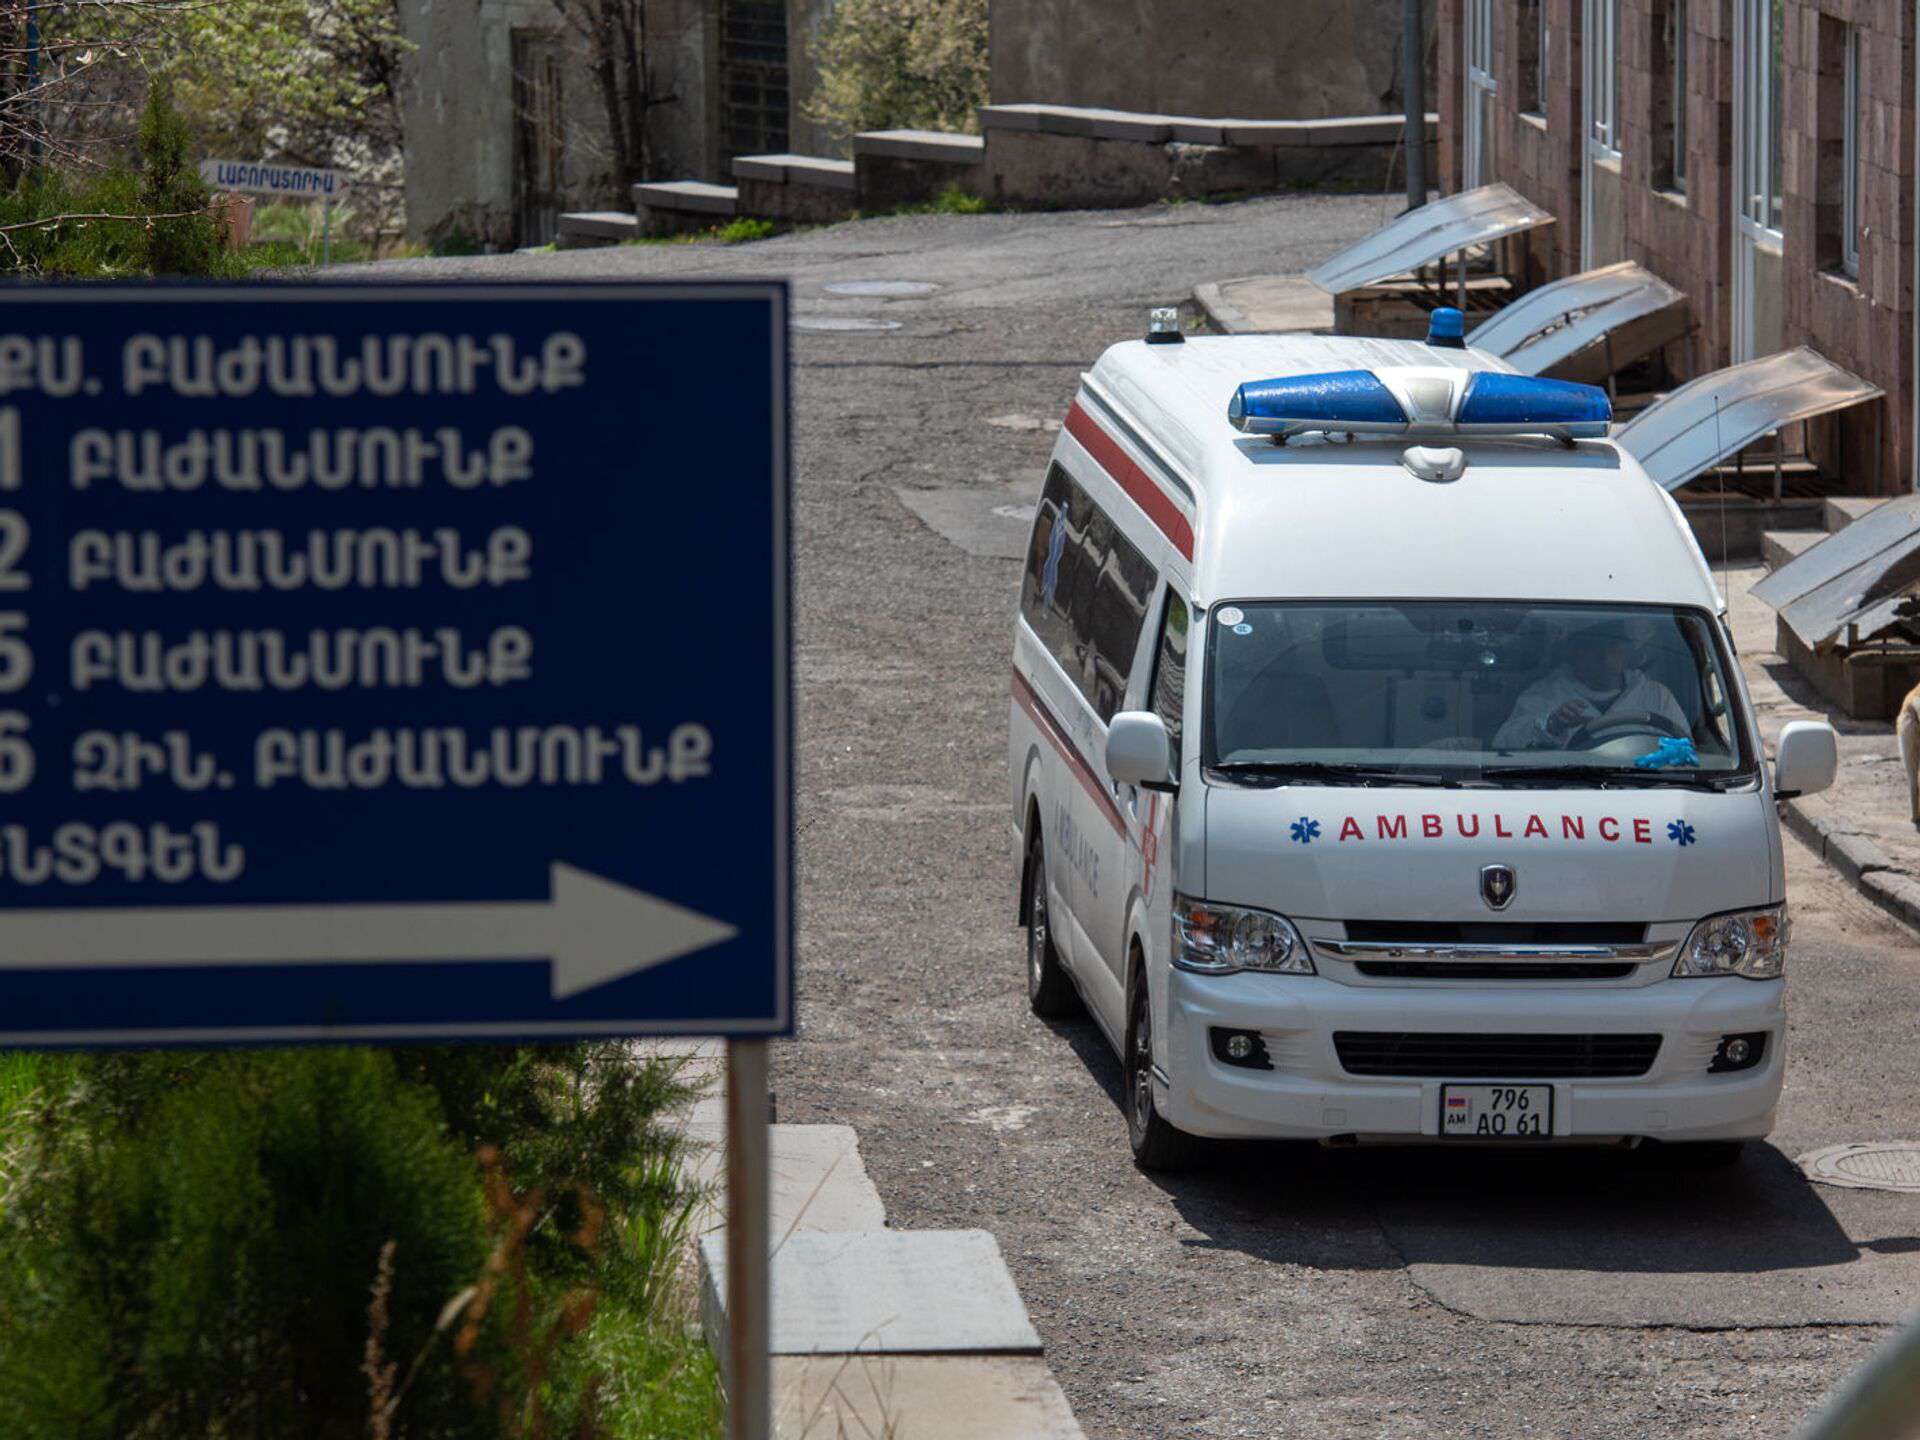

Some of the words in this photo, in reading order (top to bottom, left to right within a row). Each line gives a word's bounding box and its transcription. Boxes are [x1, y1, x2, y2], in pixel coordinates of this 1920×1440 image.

[217, 164, 334, 193] ԼԱԲՈՐԱՏՈՐԻԱ
[123, 332, 586, 397] ԲԱԺԱՆՄՈՒՆՔ
[70, 426, 533, 491] ԲԱԺԱՆՄՈՒՆՔ
[69, 526, 532, 591] ԲԱԺԱՆՄՈՒՆՔ
[71, 626, 533, 691] ԲԱԺԱՆՄՈՒՆՔ
[255, 723, 713, 790] ԲԱԺԱՆՄՈՒՆՔ
[0, 822, 245, 884] ՆՏԳԵՆ
[1338, 813, 1653, 845] AMBULANCE
[1447, 1113, 1466, 1125] AM
[1491, 1088, 1530, 1111] 796
[1516, 1112, 1541, 1136] 61
